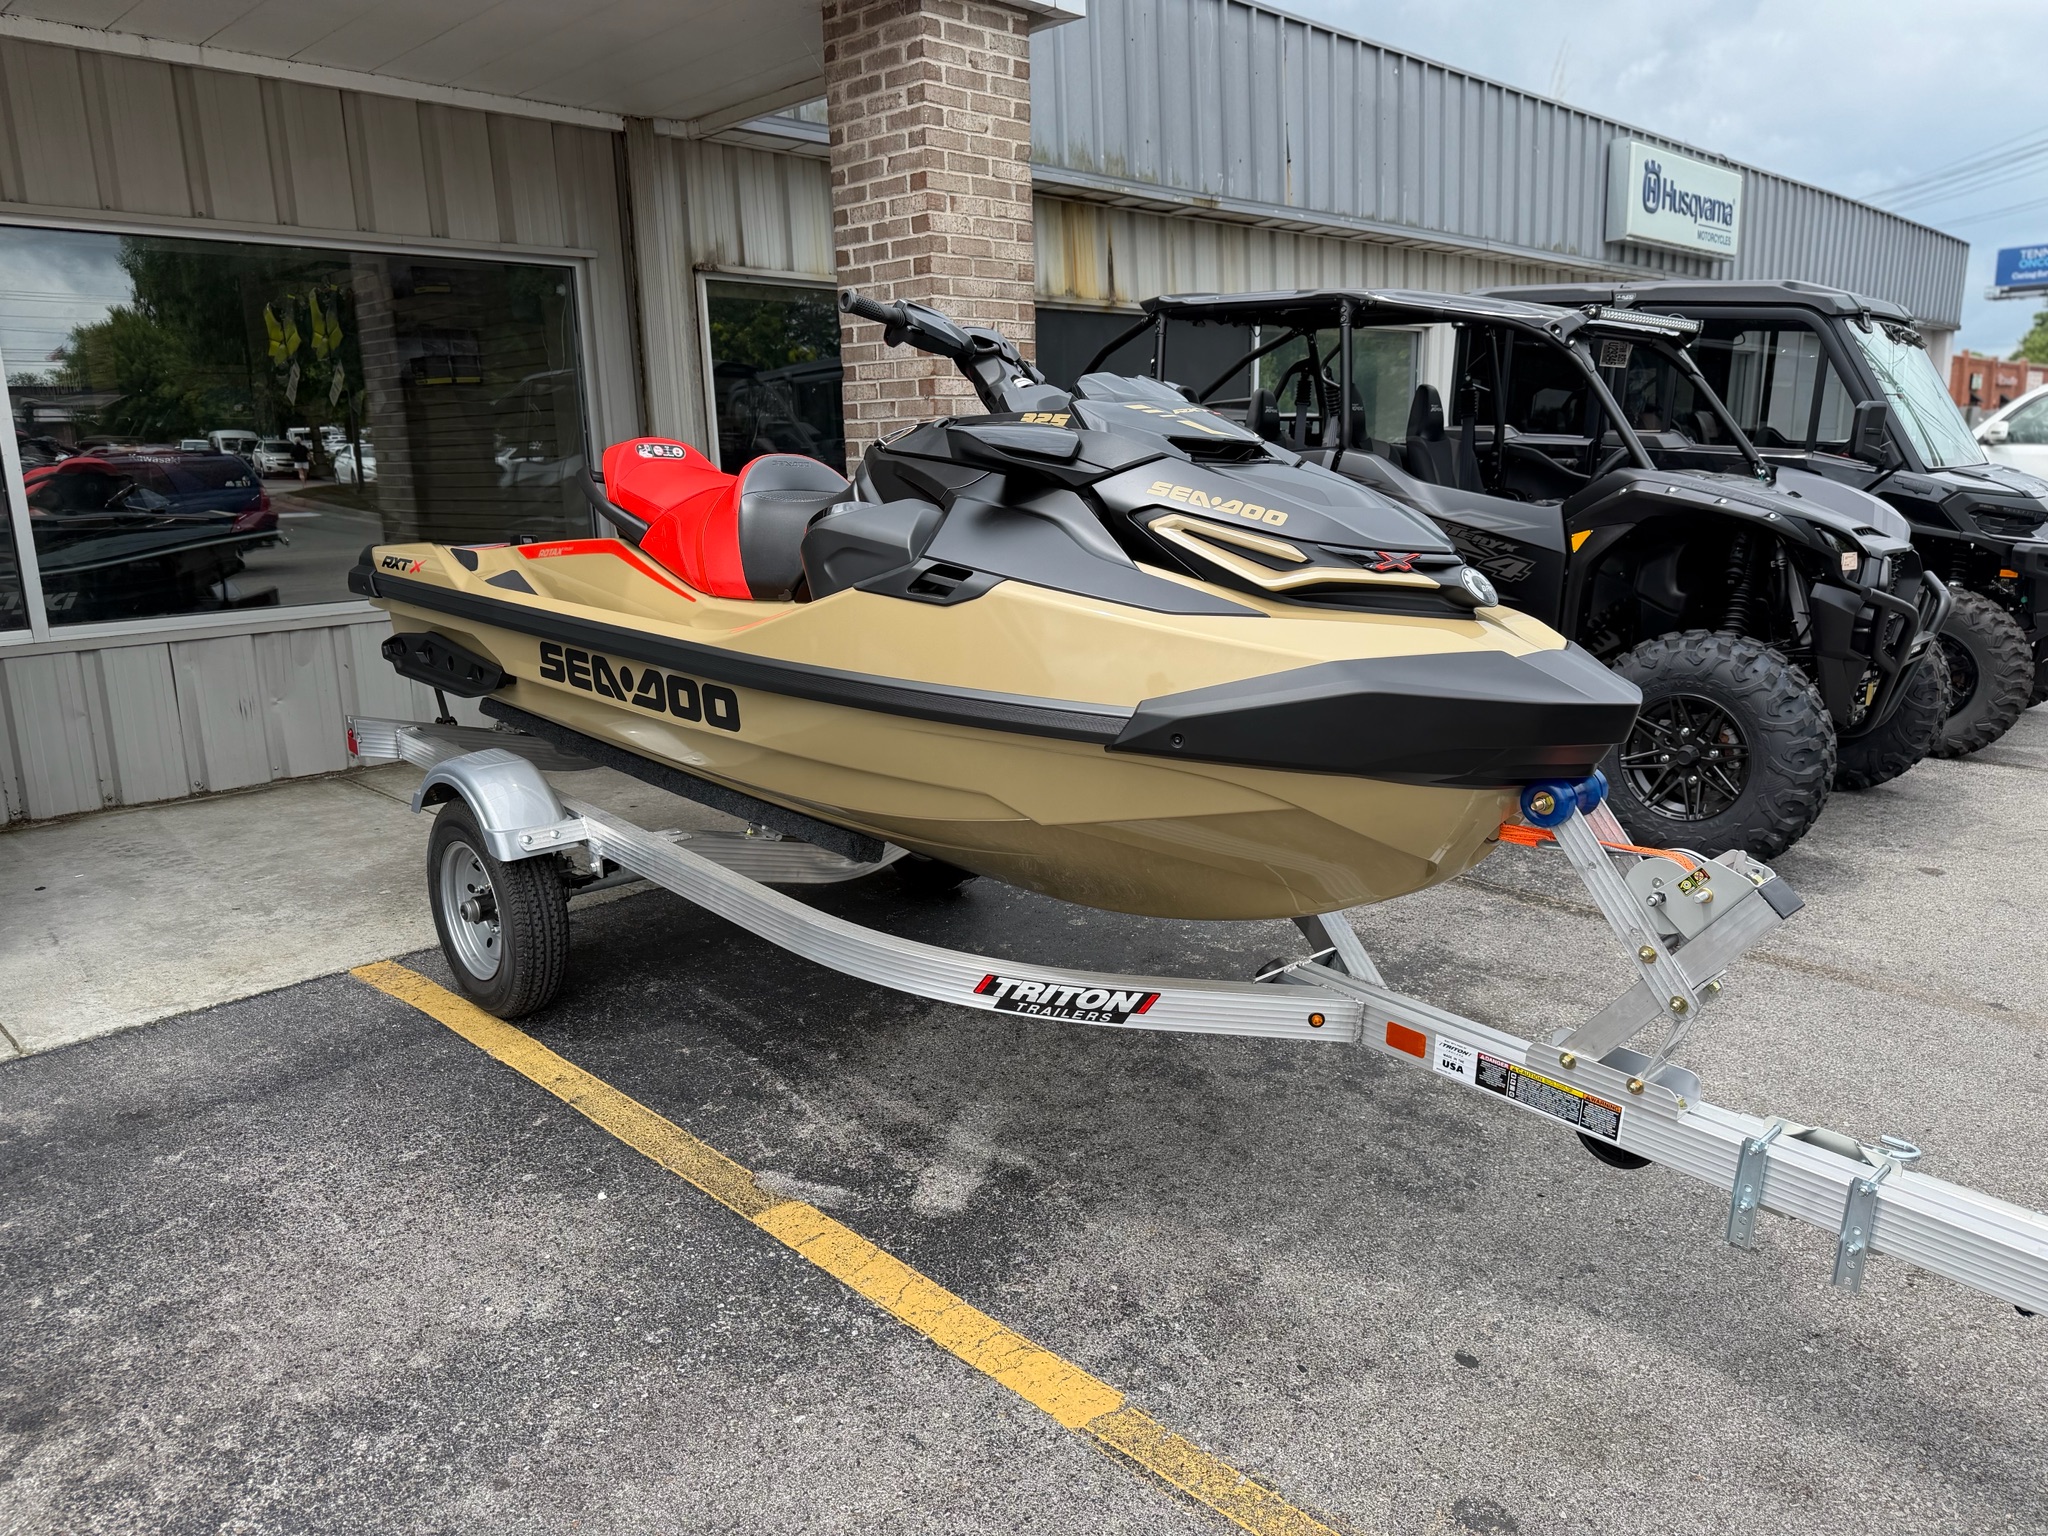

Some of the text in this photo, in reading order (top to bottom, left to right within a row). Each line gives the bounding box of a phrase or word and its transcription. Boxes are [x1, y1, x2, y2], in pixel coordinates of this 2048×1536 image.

[1661, 177, 1733, 226] Husqvarna
[1696, 229, 1732, 247] MOTORCYCLES
[128, 453, 181, 465] Kawasaki
[1669, 478, 1777, 510] BLACKOUT EDITION
[1445, 523, 1520, 552] TERYX
[538, 547, 564, 558] ROTAX
[381, 556, 413, 571] RXT
[1478, 555, 1535, 581] 4
[994, 976, 1144, 1013] TRITON
[1016, 1002, 1113, 1023] TRAILERS
[1442, 1059, 1464, 1074] USA
[1484, 1056, 1509, 1070] DANGER
[1517, 1067, 1543, 1082] CAUTION
[1591, 1096, 1618, 1112] WARNING
